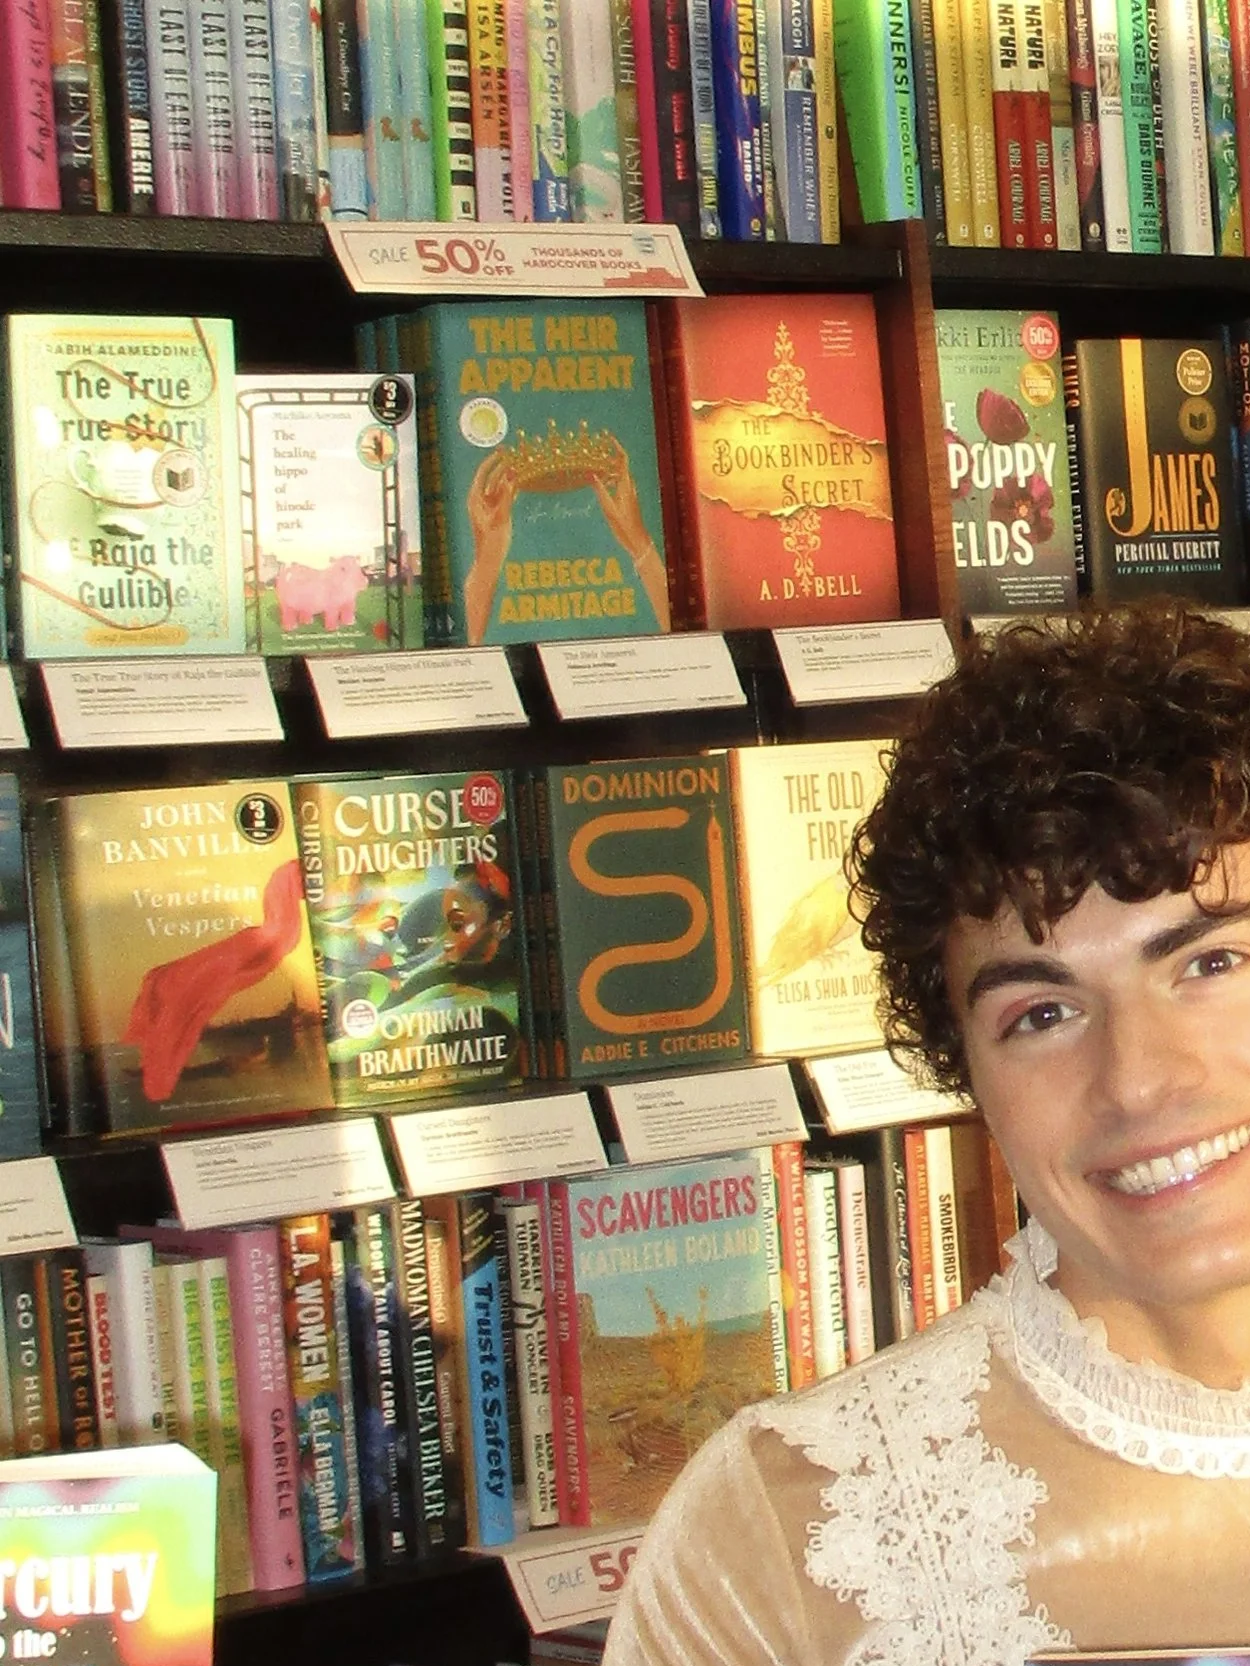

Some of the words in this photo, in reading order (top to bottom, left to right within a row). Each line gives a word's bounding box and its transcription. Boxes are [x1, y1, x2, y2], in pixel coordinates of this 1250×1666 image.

[129, 118, 153, 194] AMERIE
[483, 265, 515, 277] OFF
[469, 317, 535, 352] THE
[546, 315, 618, 351] HEIR
[57, 372, 111, 400] The
[124, 373, 190, 399] True
[460, 355, 635, 394] APPARENT
[742, 419, 771, 436] THE
[1106, 338, 1220, 537] JAMES
[950, 443, 1055, 488] POPPY
[782, 475, 864, 506] SECRET
[91, 539, 156, 573] Raja
[1115, 541, 1169, 563] PERCIVAL
[1174, 540, 1221, 559] EVERETT
[506, 558, 621, 589] REBECCA
[814, 576, 861, 597] BELL
[499, 590, 635, 624] ARMITAGE
[563, 768, 720, 805] DOMINION
[784, 775, 820, 814] THE
[828, 771, 863, 812] OLD
[140, 801, 227, 829] JOHN
[337, 834, 498, 876] DAUGHTERS
[133, 884, 258, 910] Venetian
[145, 913, 253, 938] Vespers
[380, 1006, 484, 1041] OYINKAN
[360, 1035, 507, 1078] BRAITHWAITE
[577, 1177, 758, 1240] SCAVENGERS
[580, 1240, 676, 1277] KATHLEEN
[685, 1228, 761, 1261] BOLAND
[940, 1194, 956, 1282] SMOKEBIRDS
[400, 1202, 429, 1330] MADWOMAN
[61, 1268, 88, 1378] MOTHER
[295, 1280, 329, 1383] WOMEN
[475, 1283, 495, 1364] Trust
[411, 1336, 437, 1433] CHELSEA
[481, 1398, 506, 1499] Safety
[420, 1441, 445, 1520] BIEKER
[13, 1630, 56, 1659] the
